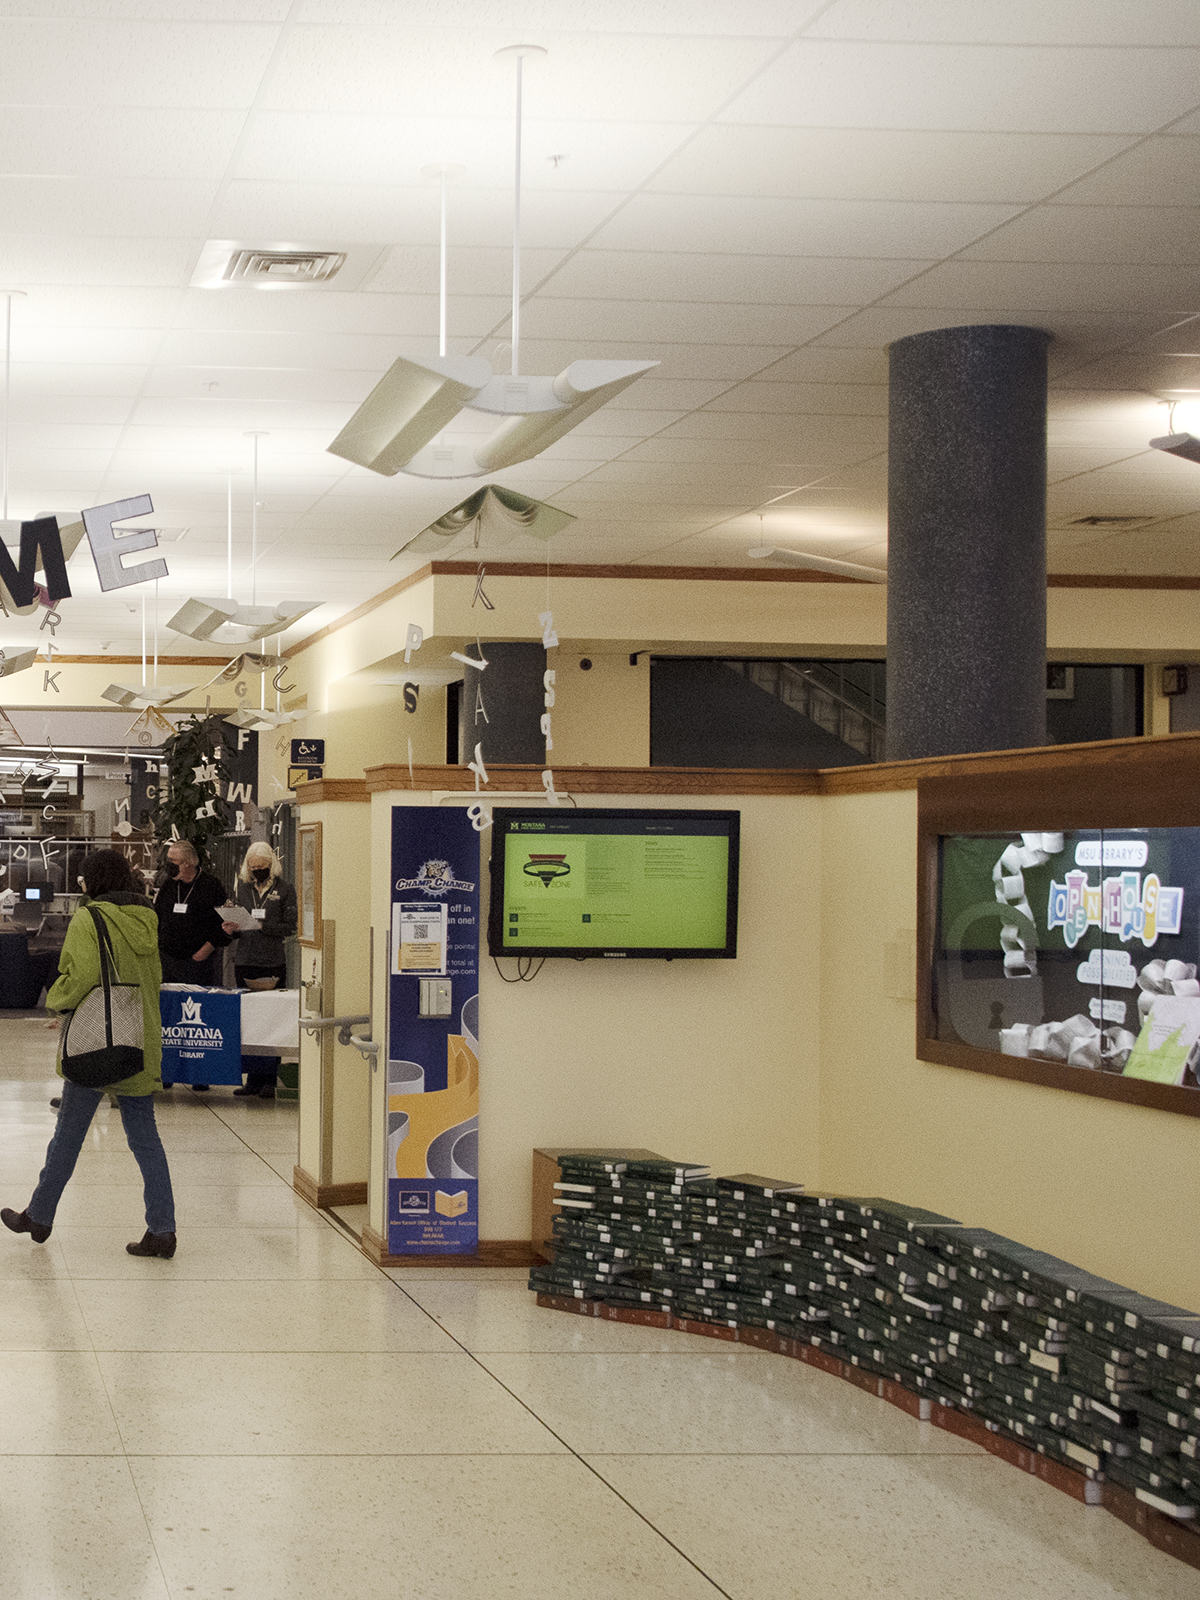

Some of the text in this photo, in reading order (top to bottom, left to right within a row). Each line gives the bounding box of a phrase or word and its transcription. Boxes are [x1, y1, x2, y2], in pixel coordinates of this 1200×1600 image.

[1098, 847, 1144, 860] LBRARY'S
[396, 877, 475, 892] CHAMP CHANGE
[450, 904, 471, 912] off in
[457, 916, 475, 924] one!
[1090, 953, 1128, 968] OPNING
[1082, 966, 1135, 981] POSSBILITIES
[161, 1027, 224, 1040] MONTANA
[161, 1038, 224, 1048] STATE UNIVERSITY
